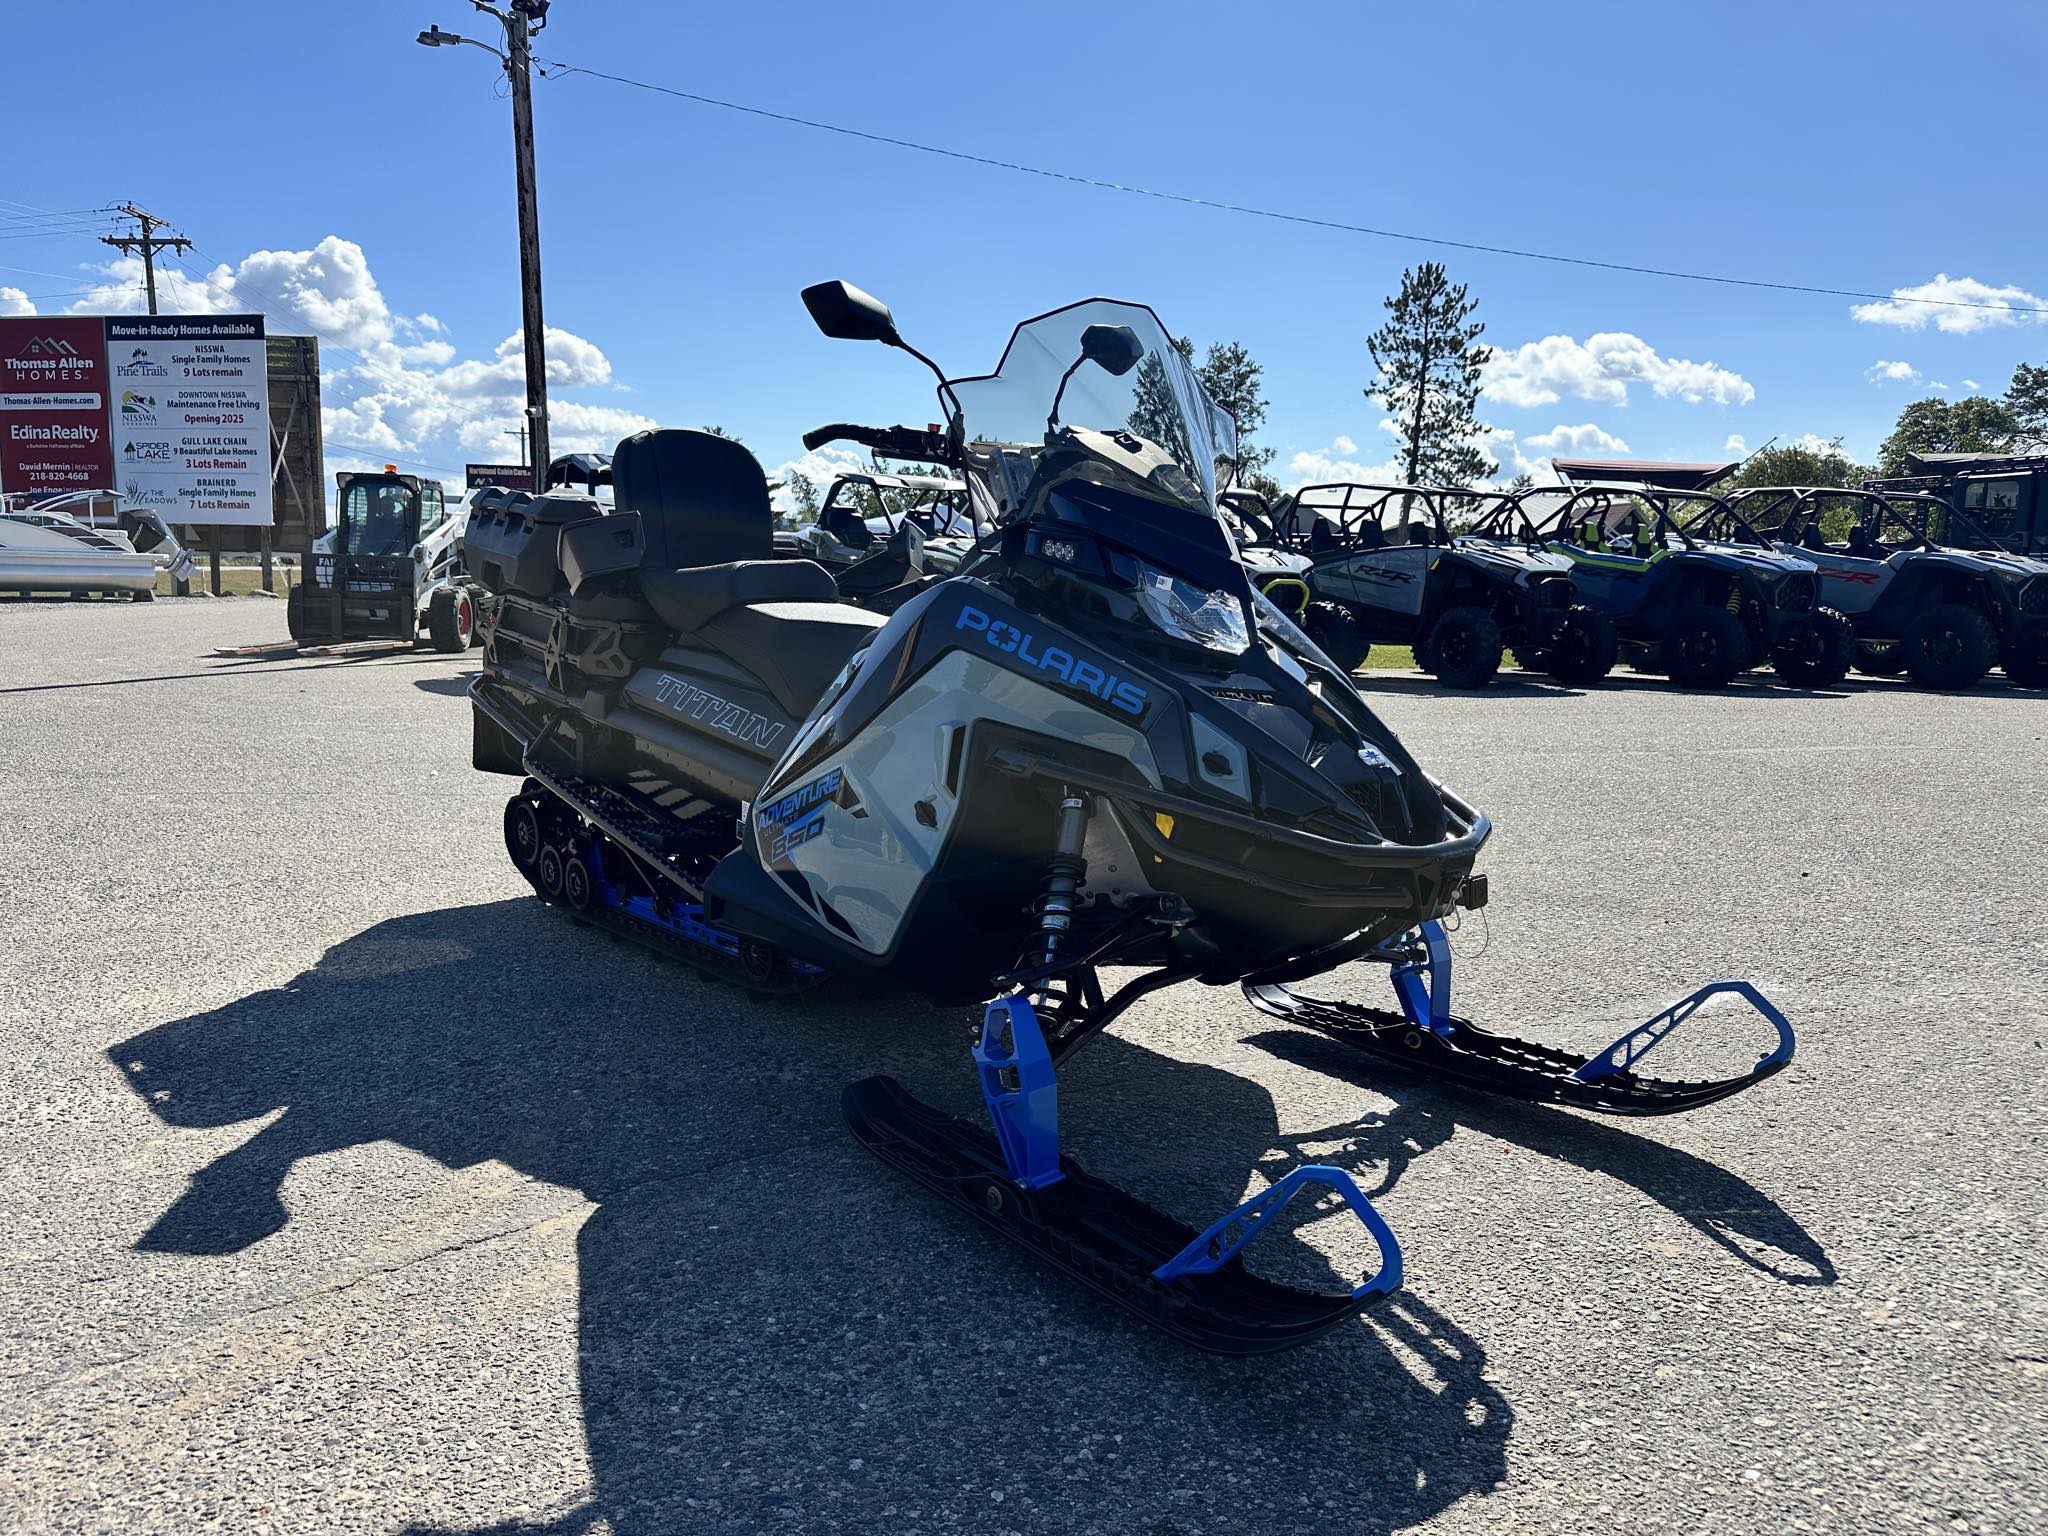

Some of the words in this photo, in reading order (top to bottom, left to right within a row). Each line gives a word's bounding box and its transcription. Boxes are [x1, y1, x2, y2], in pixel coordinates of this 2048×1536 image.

[112, 325, 179, 337] Move-in-Ready
[180, 325, 211, 334] Homes
[212, 324, 256, 334] Available
[195, 345, 225, 353] NISSWA
[4, 358, 57, 369] Thomas
[59, 357, 94, 369] Allen
[171, 355, 195, 365] Single
[196, 355, 222, 365] Family
[223, 355, 251, 364] Homes
[16, 370, 82, 380] HOMES
[117, 366, 138, 377] Pine
[138, 366, 168, 377] Trails
[183, 368, 190, 377] 9
[192, 368, 210, 377] Lots
[211, 368, 243, 377] remain
[178, 391, 219, 399] DOWNTOWN
[220, 391, 247, 399] NISSWA
[3, 396, 95, 405] Thomas-Allen-Homes.com
[167, 400, 217, 409] Maintenance
[217, 400, 235, 409] Free
[235, 400, 260, 410] Living
[122, 414, 157, 422] NISSWA
[184, 414, 220, 425] Opening
[221, 414, 244, 423] 2025
[10, 424, 51, 440] Edina
[135, 442, 169, 450] SPIDER
[182, 437, 201, 446] GULL
[202, 437, 222, 446] LAKE
[223, 437, 247, 446] CHAIN
[136, 450, 170, 459] LAKE
[179, 447, 213, 456] Beautiful
[213, 447, 232, 456] Lake
[232, 448, 258, 456] Homes
[19, 463, 41, 471] David
[42, 463, 70, 471] Mernin
[185, 459, 192, 469] 3
[193, 459, 212, 469] Lots
[213, 459, 247, 469] Remain
[30, 472, 89, 481] 218-820-4668
[196, 479, 237, 487] BRAINERD
[29, 486, 43, 494] Joe
[178, 488, 202, 497] Single
[203, 488, 230, 498] Family
[230, 489, 257, 497] Homes
[189, 500, 195, 509] 7
[198, 500, 216, 509] Lots
[217, 500, 250, 509] Remain
[1354, 564, 1416, 584] RZR
[955, 605, 1149, 715] POLARIS
[656, 674, 785, 749] TITAN
[757, 770, 842, 833] ADVENTURE
[763, 811, 800, 837] ULTIMATE
[771, 815, 825, 864] 850
